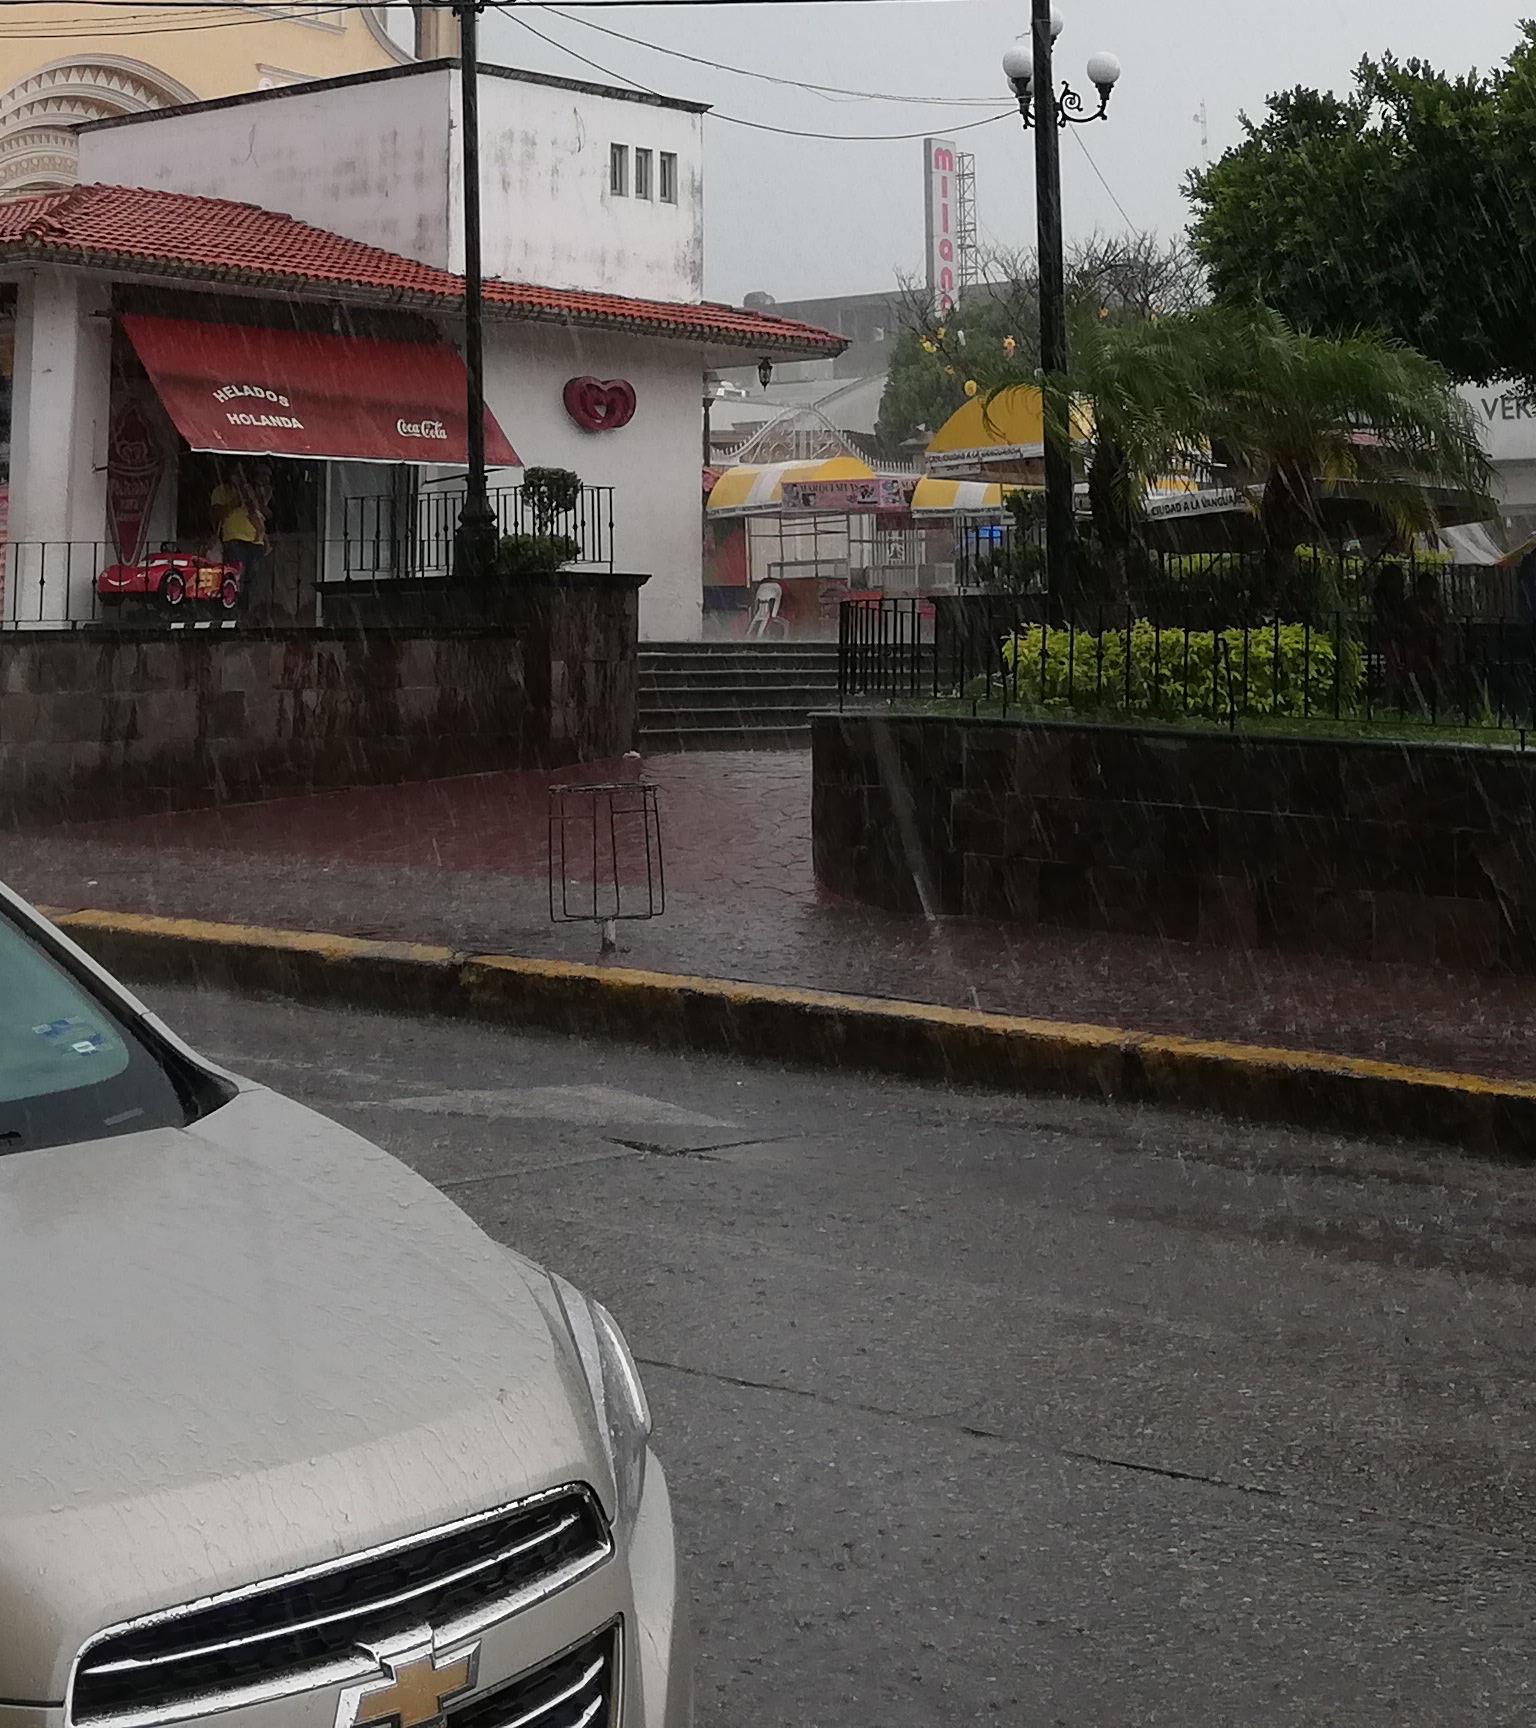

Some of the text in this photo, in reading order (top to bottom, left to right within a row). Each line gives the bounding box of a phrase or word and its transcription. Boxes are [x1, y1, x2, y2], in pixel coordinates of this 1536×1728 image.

[212, 384, 290, 408] HELADOS
[226, 412, 304, 430] HOLANDA
[1151, 502, 1182, 516] CIUDAD
[1183, 502, 1190, 512] A
[1191, 500, 1201, 510] LA
